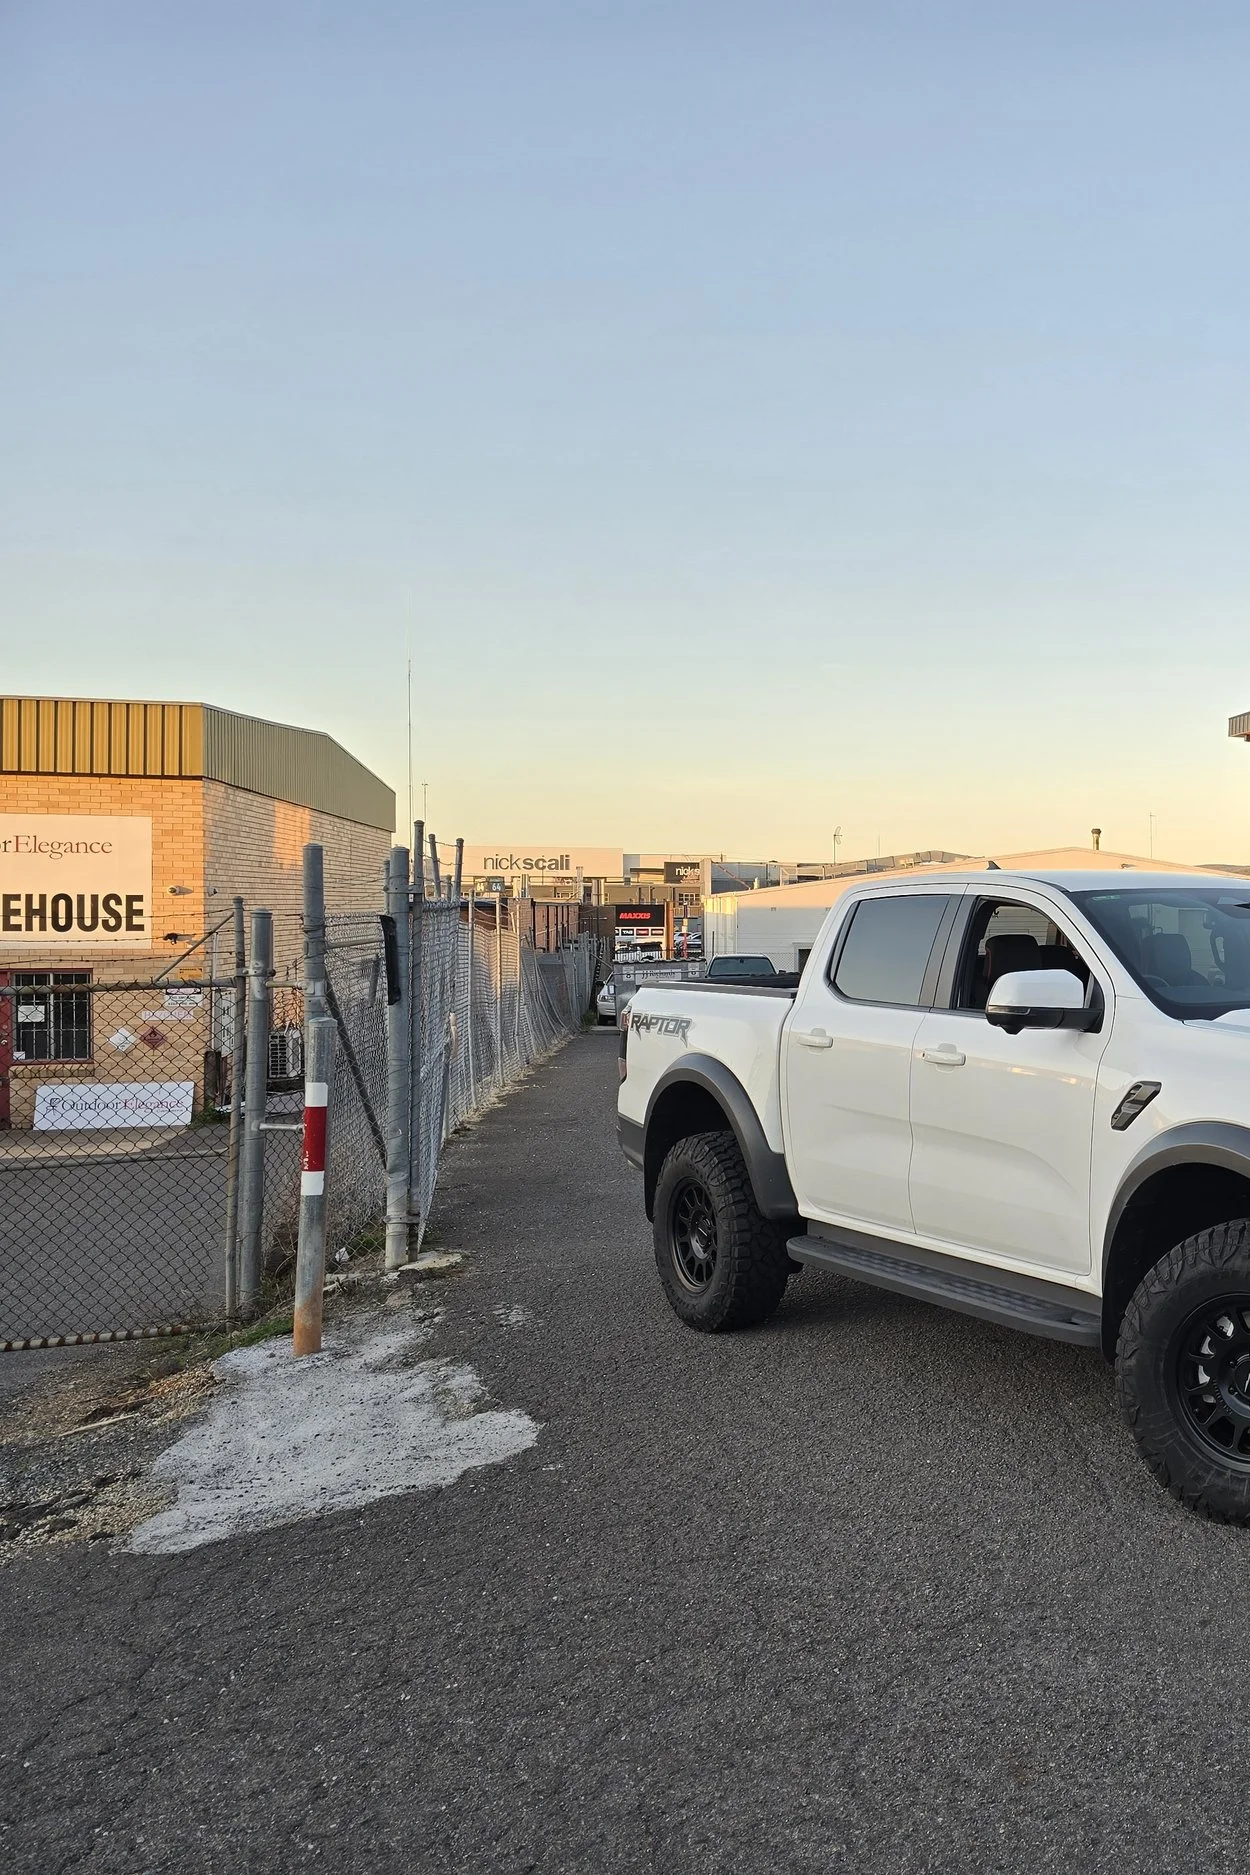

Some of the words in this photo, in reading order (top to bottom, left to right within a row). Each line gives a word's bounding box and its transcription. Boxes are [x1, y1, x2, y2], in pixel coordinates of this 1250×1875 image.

[13, 834, 113, 860] Elegance
[492, 882, 501, 891] 64
[2, 892, 145, 933] EHOUSE
[630, 1012, 692, 1048] RAPTOR
[61, 1097, 121, 1112] Outdoor
[123, 1097, 184, 1114] Elegance
